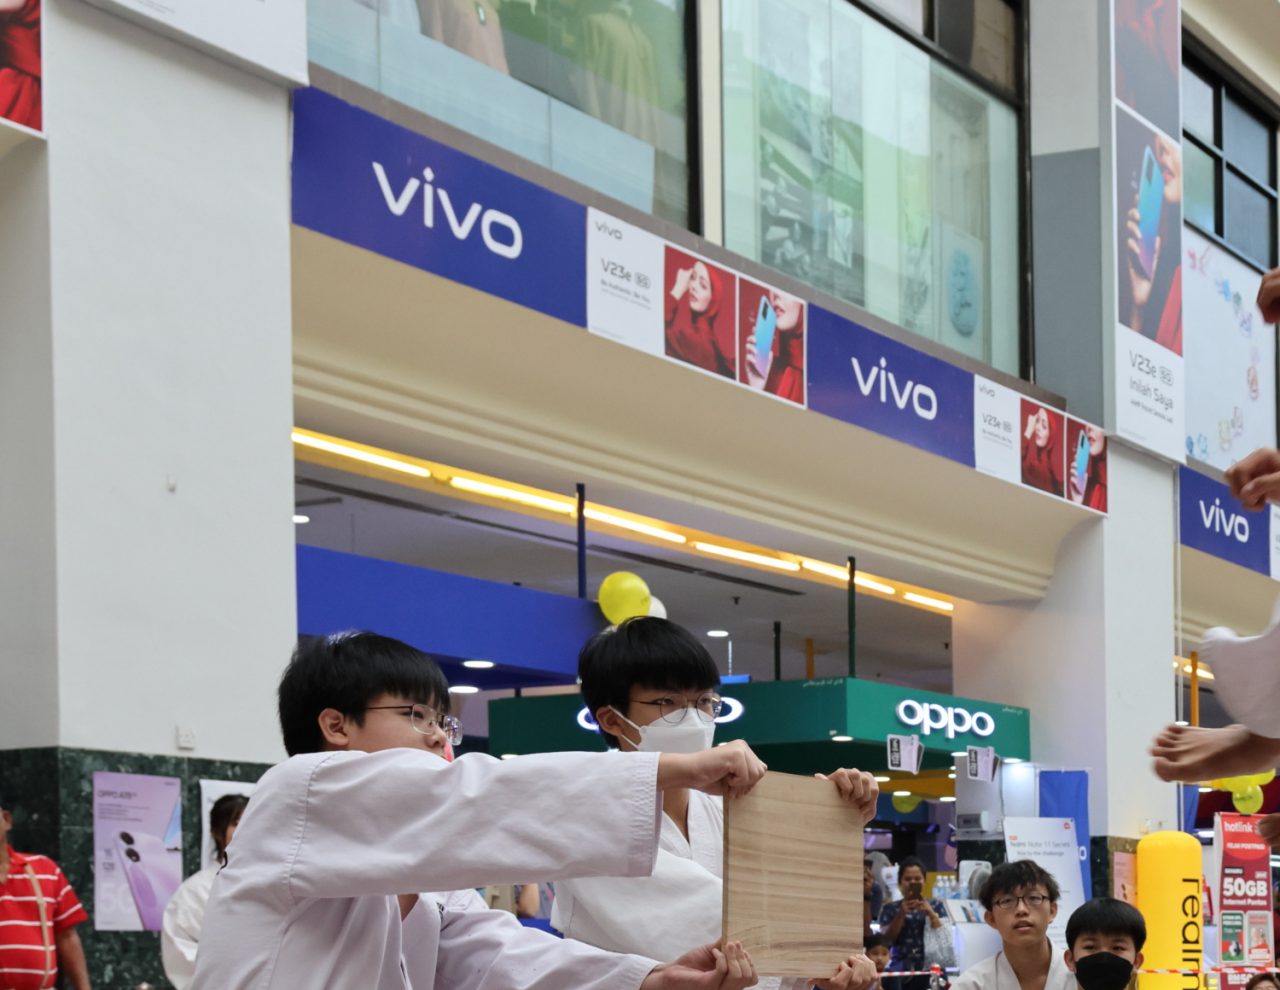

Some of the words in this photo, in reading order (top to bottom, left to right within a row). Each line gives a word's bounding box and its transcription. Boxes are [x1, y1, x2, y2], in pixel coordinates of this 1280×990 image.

[371, 160, 524, 259] vivo
[595, 220, 623, 240] vivo
[601, 258, 632, 282] V23e
[1129, 348, 1157, 378] V23e
[850, 356, 938, 421] vivo
[1199, 497, 1250, 543] vivo
[897, 699, 995, 739] oppo
[1224, 821, 1253, 833] hotlink
[1222, 877, 1268, 897] 50GB
